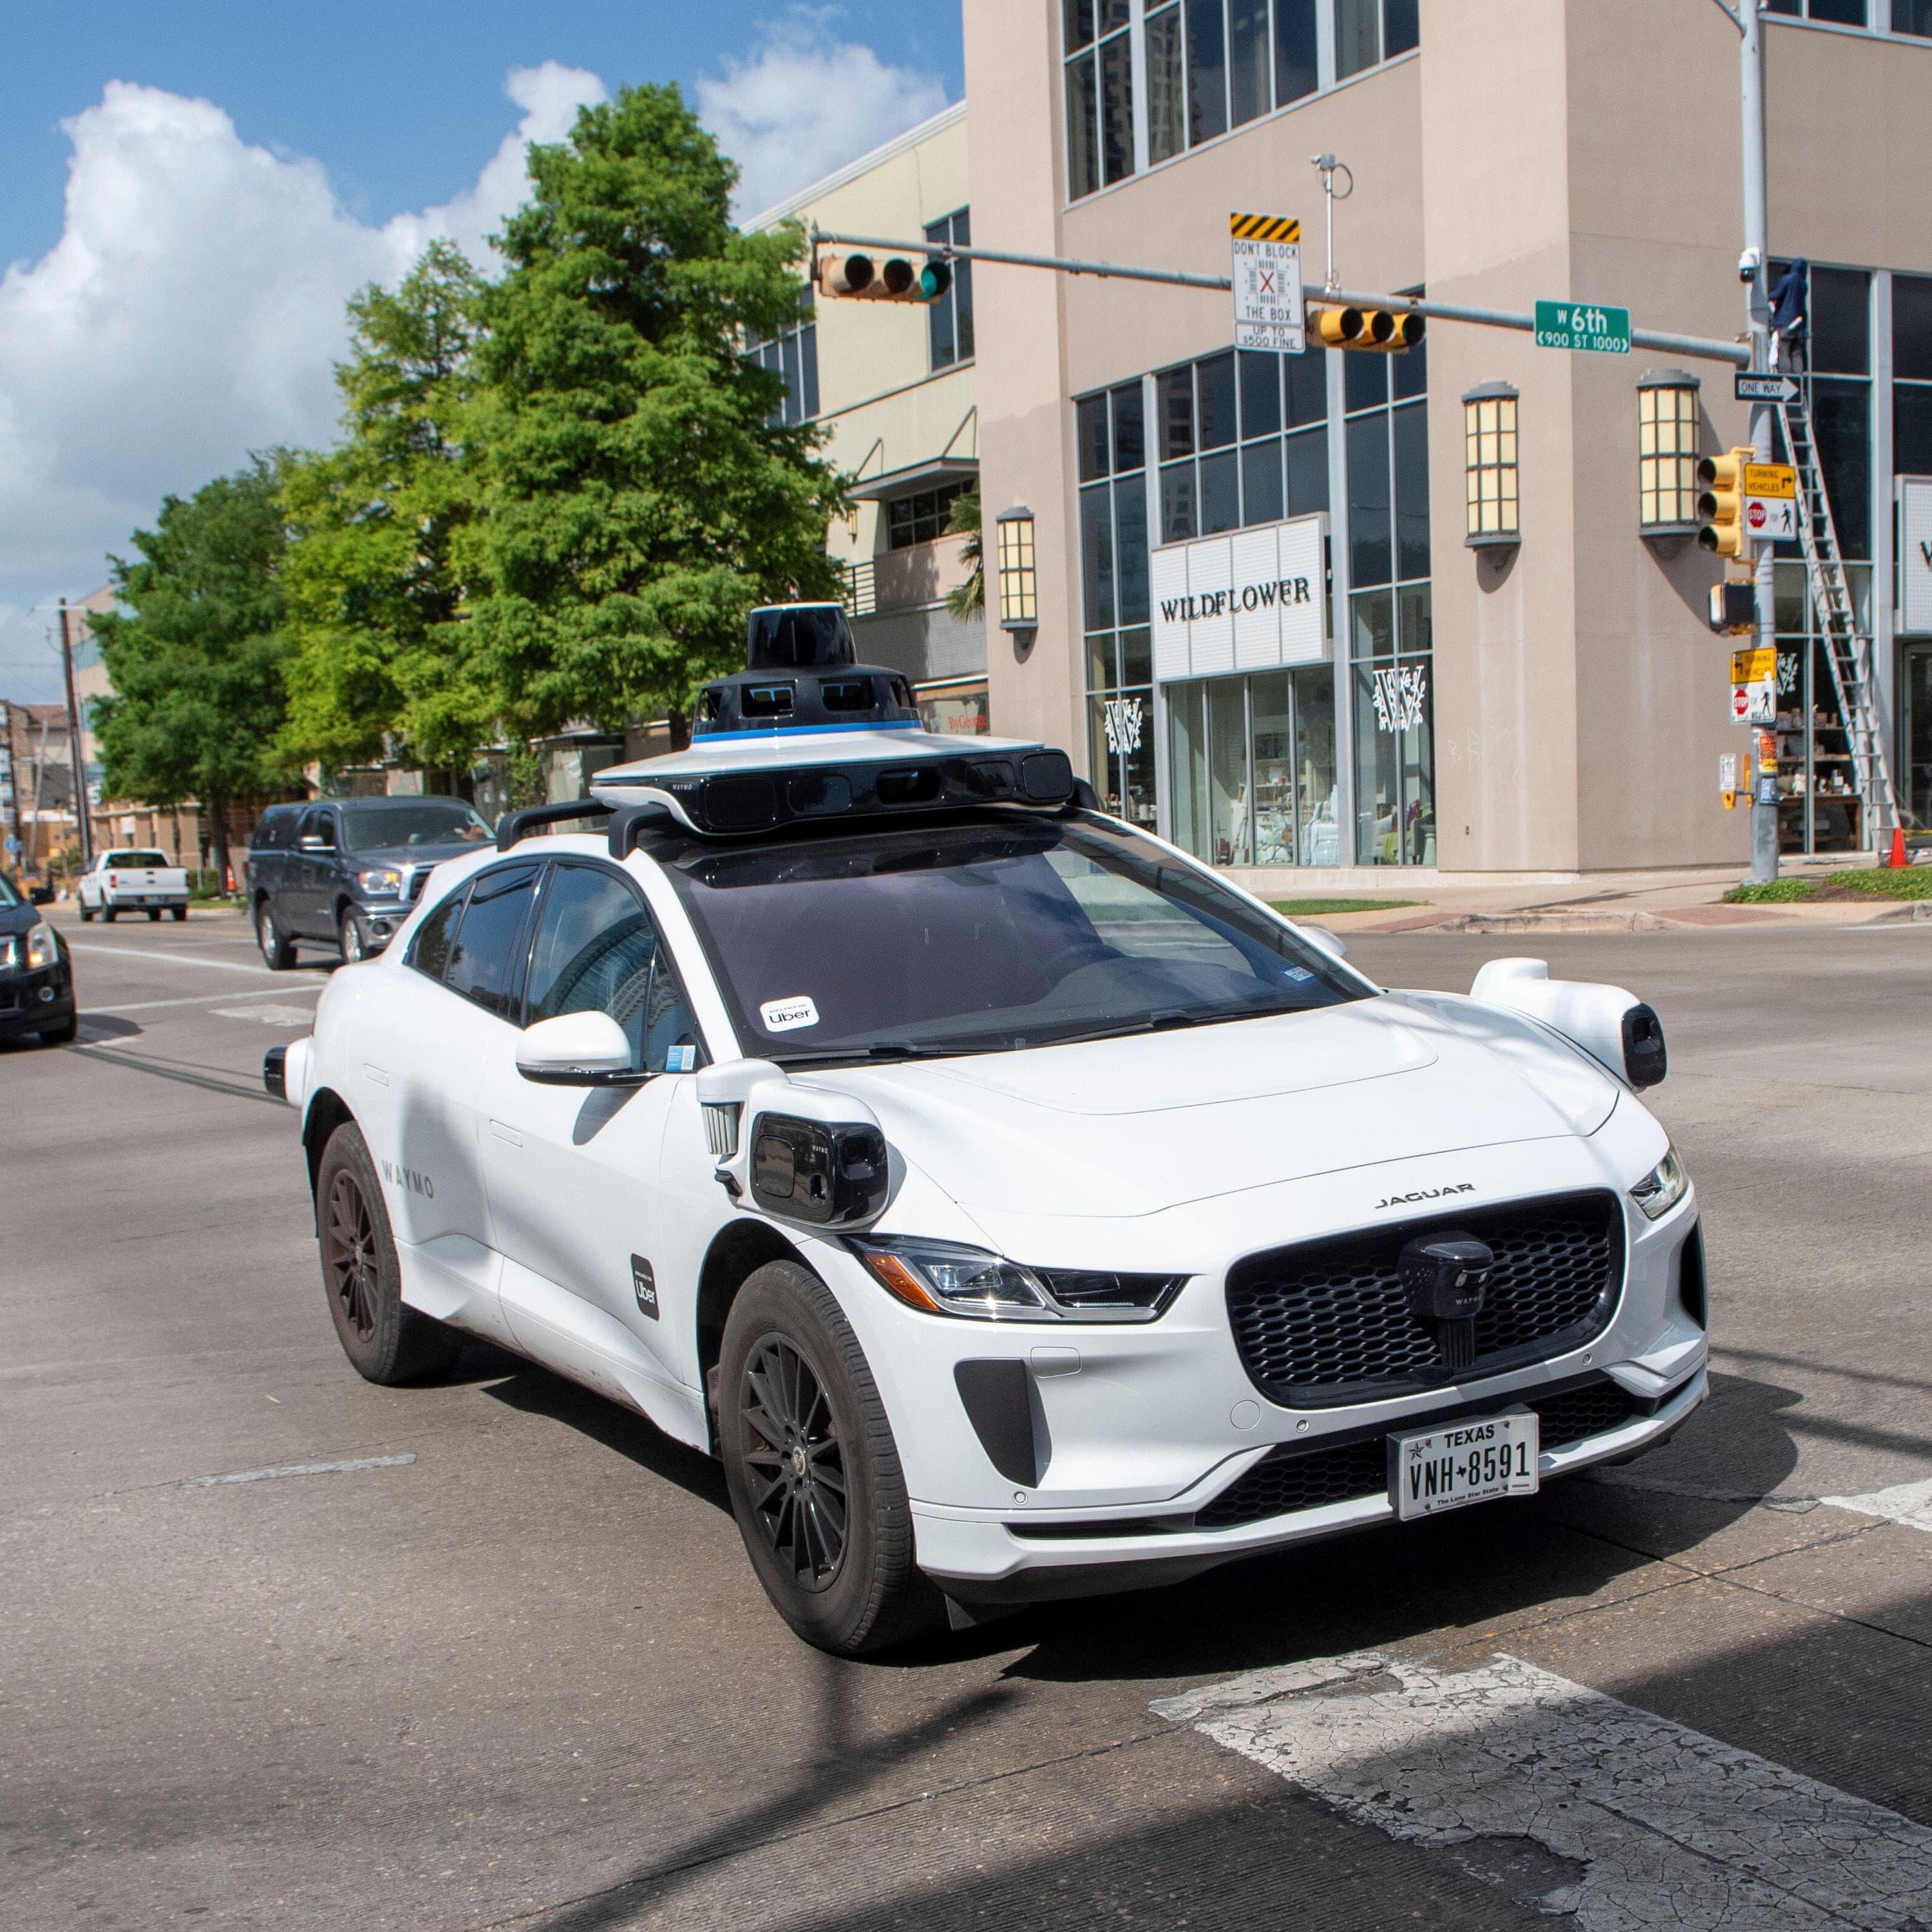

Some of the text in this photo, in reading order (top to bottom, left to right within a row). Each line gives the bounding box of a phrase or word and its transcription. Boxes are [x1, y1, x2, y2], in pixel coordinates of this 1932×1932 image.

[1266, 243, 1298, 259] BLOCK
[1246, 306, 1291, 321] THE BOX
[1557, 307, 1607, 334] W 6th
[1253, 325, 1285, 337] UP TO
[1244, 335, 1296, 349] $500 FINE
[1546, 331, 1621, 351] 900 ST 1000
[1741, 381, 1782, 394] ONE WAY
[1750, 469, 1779, 478] TURNING
[1749, 482, 1779, 492] VEHICLES
[1748, 509, 1766, 522] STOP
[1160, 577, 1311, 623] WILDFLOWER
[1734, 696, 1749, 708] STOP
[769, 1009, 810, 1023] Uber
[382, 1159, 433, 1199] WAYMO
[1374, 1183, 1476, 1209] JAGUAR
[635, 1279, 656, 1304] Uber
[1444, 1424, 1495, 1448] TEXAS
[1482, 1486, 1500, 1495] State
